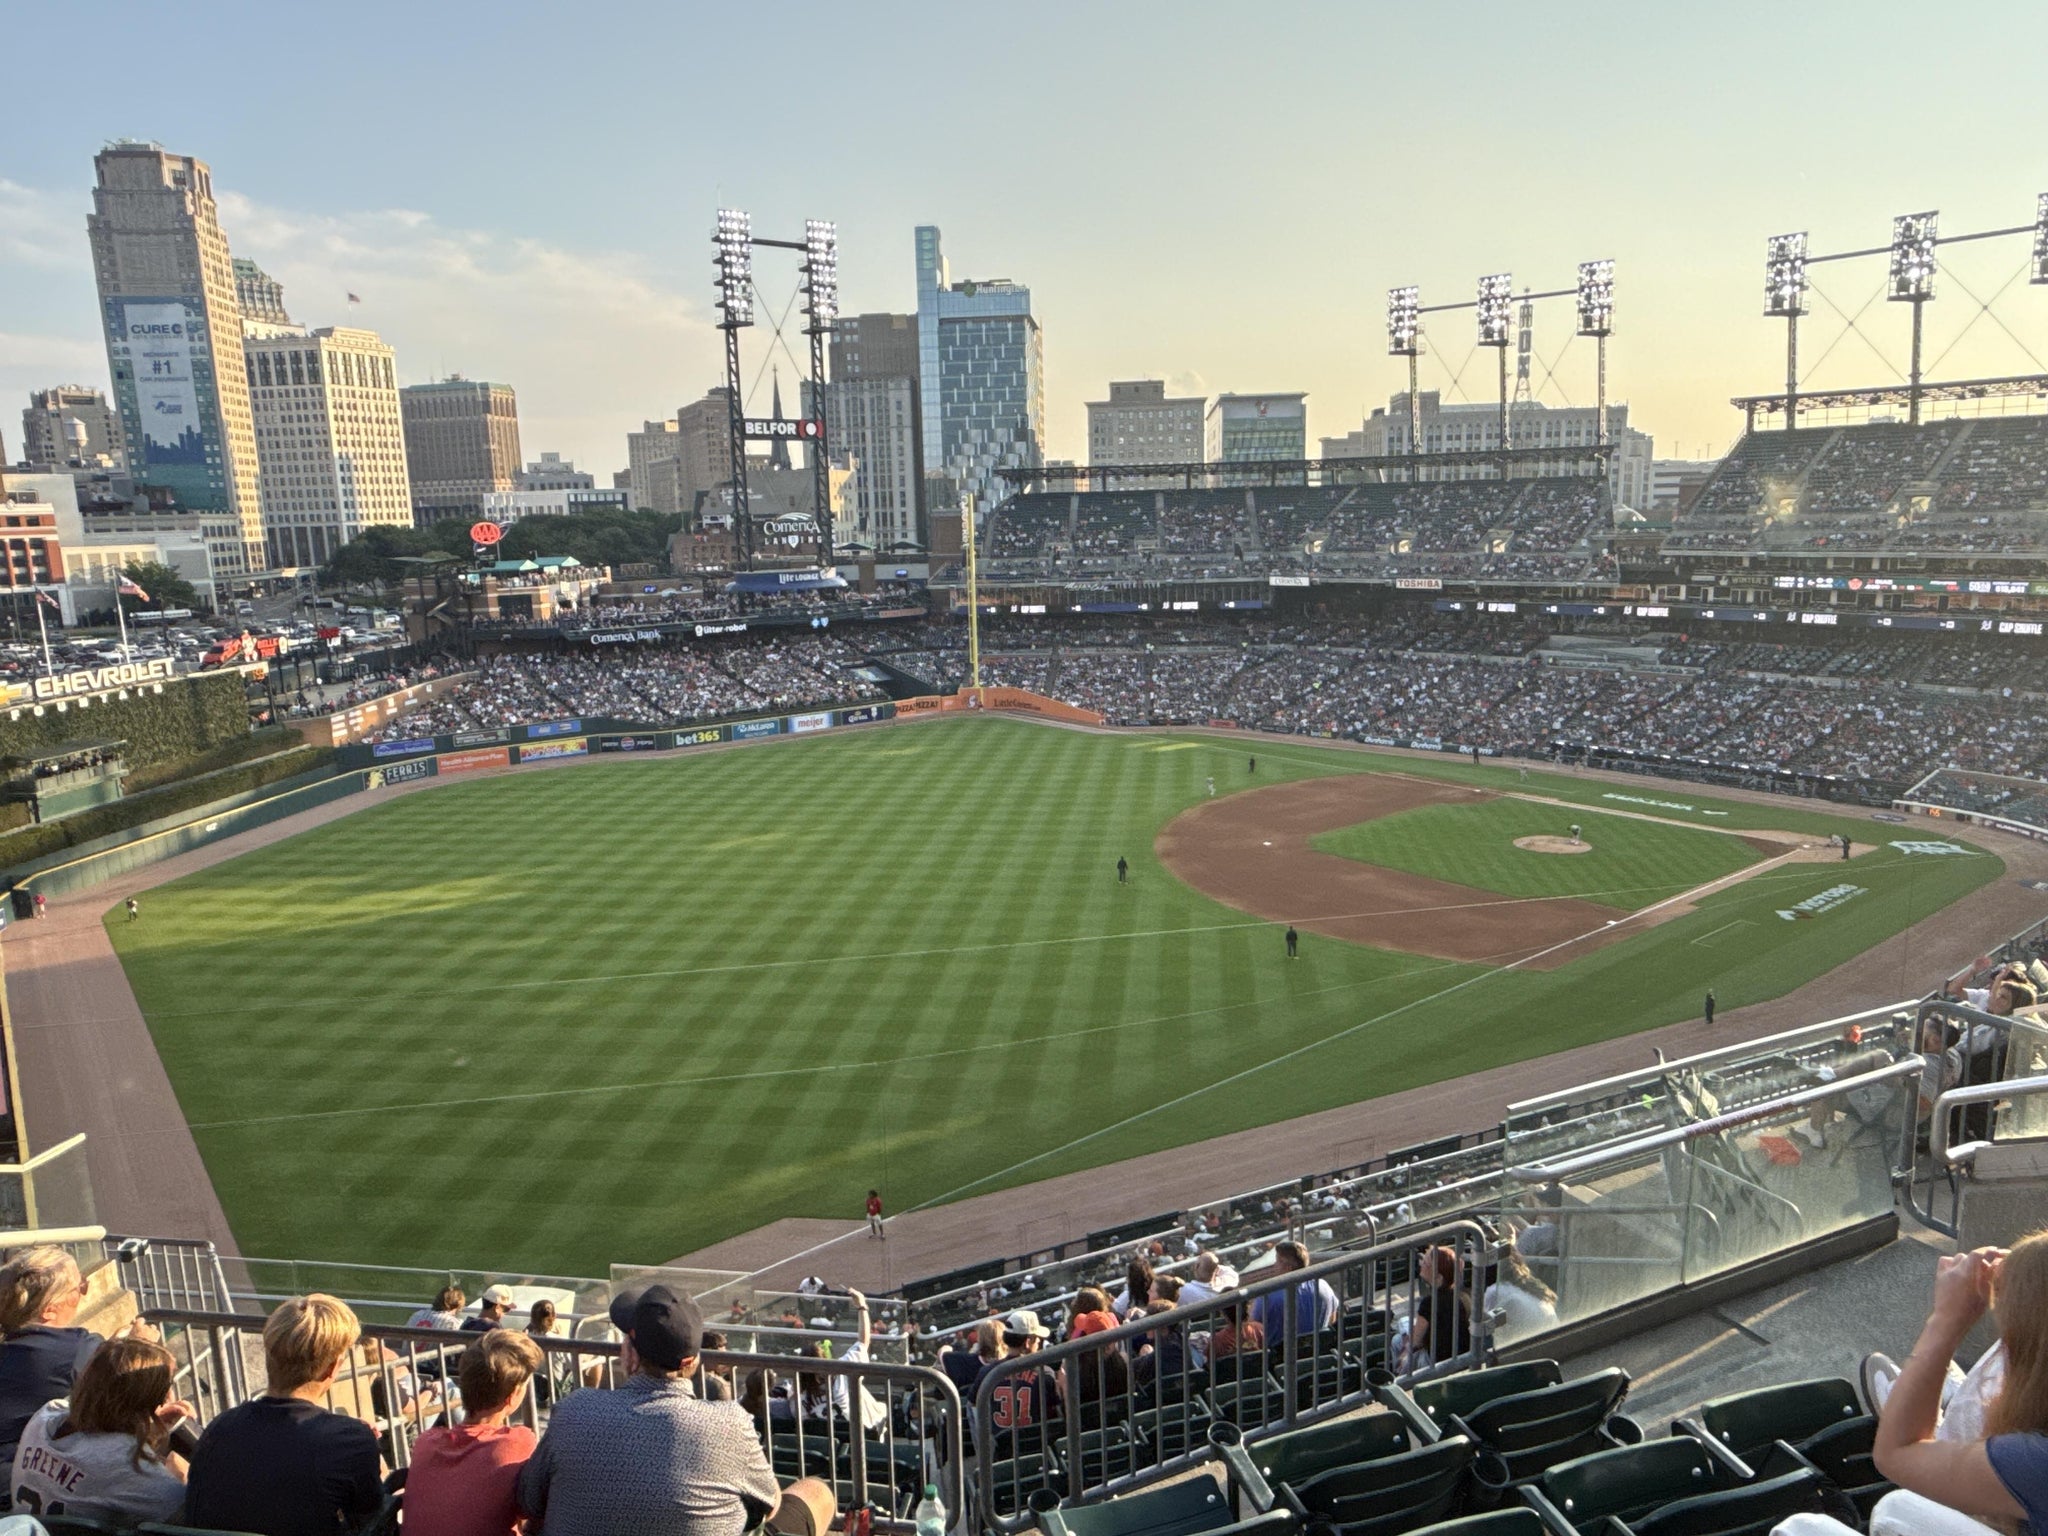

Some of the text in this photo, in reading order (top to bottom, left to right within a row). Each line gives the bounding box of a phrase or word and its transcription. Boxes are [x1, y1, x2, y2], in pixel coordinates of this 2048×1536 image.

[130, 324, 170, 334] CURE
[152, 360, 171, 375] #1
[744, 422, 797, 435] BELFOR
[473, 524, 499, 539] AAA
[779, 573, 794, 584] Lite
[1398, 579, 1440, 588] TOSHIBA
[1801, 613, 1813, 624] CAP
[636, 629, 661, 641] Bank
[1999, 621, 2043, 635] CAP SHUFFLE
[35, 657, 175, 698] CHEVROLET
[10, 683, 164, 722] FOUNTAIN
[797, 717, 824, 728] meijer
[676, 730, 720, 746] bet365
[386, 762, 427, 779] FERRIS
[993, 1386, 1033, 1429] 31
[21, 1446, 85, 1493] GREENE
